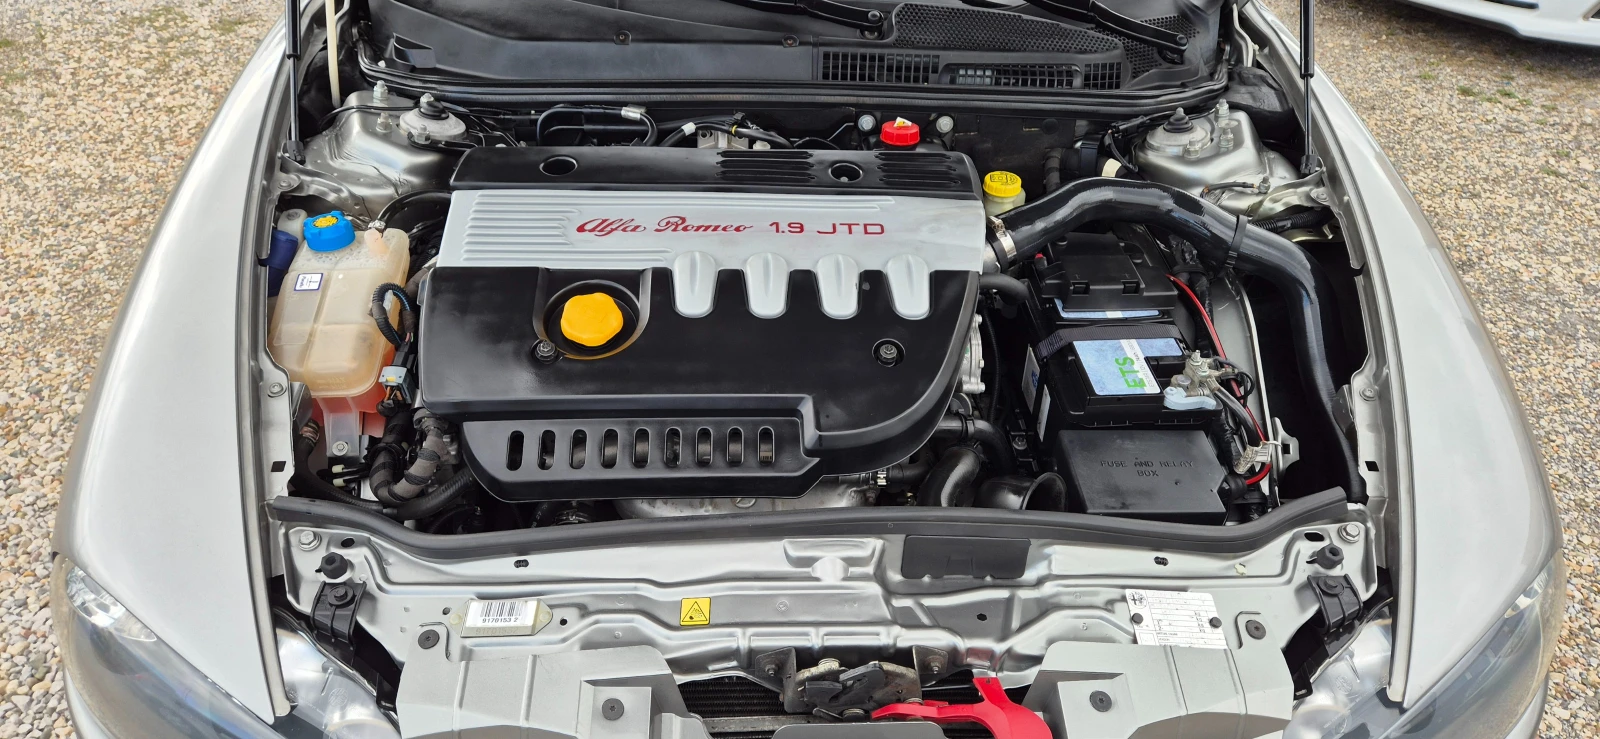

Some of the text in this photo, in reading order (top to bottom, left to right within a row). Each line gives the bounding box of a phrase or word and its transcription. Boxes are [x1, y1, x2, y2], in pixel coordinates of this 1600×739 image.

[576, 215, 886, 237] Alfa Romeo 1.9 JTD
[1114, 356, 1147, 388] ETS
[1100, 460, 1128, 468] FUSE
[1134, 460, 1154, 468] AND
[1137, 469, 1159, 477] BOX
